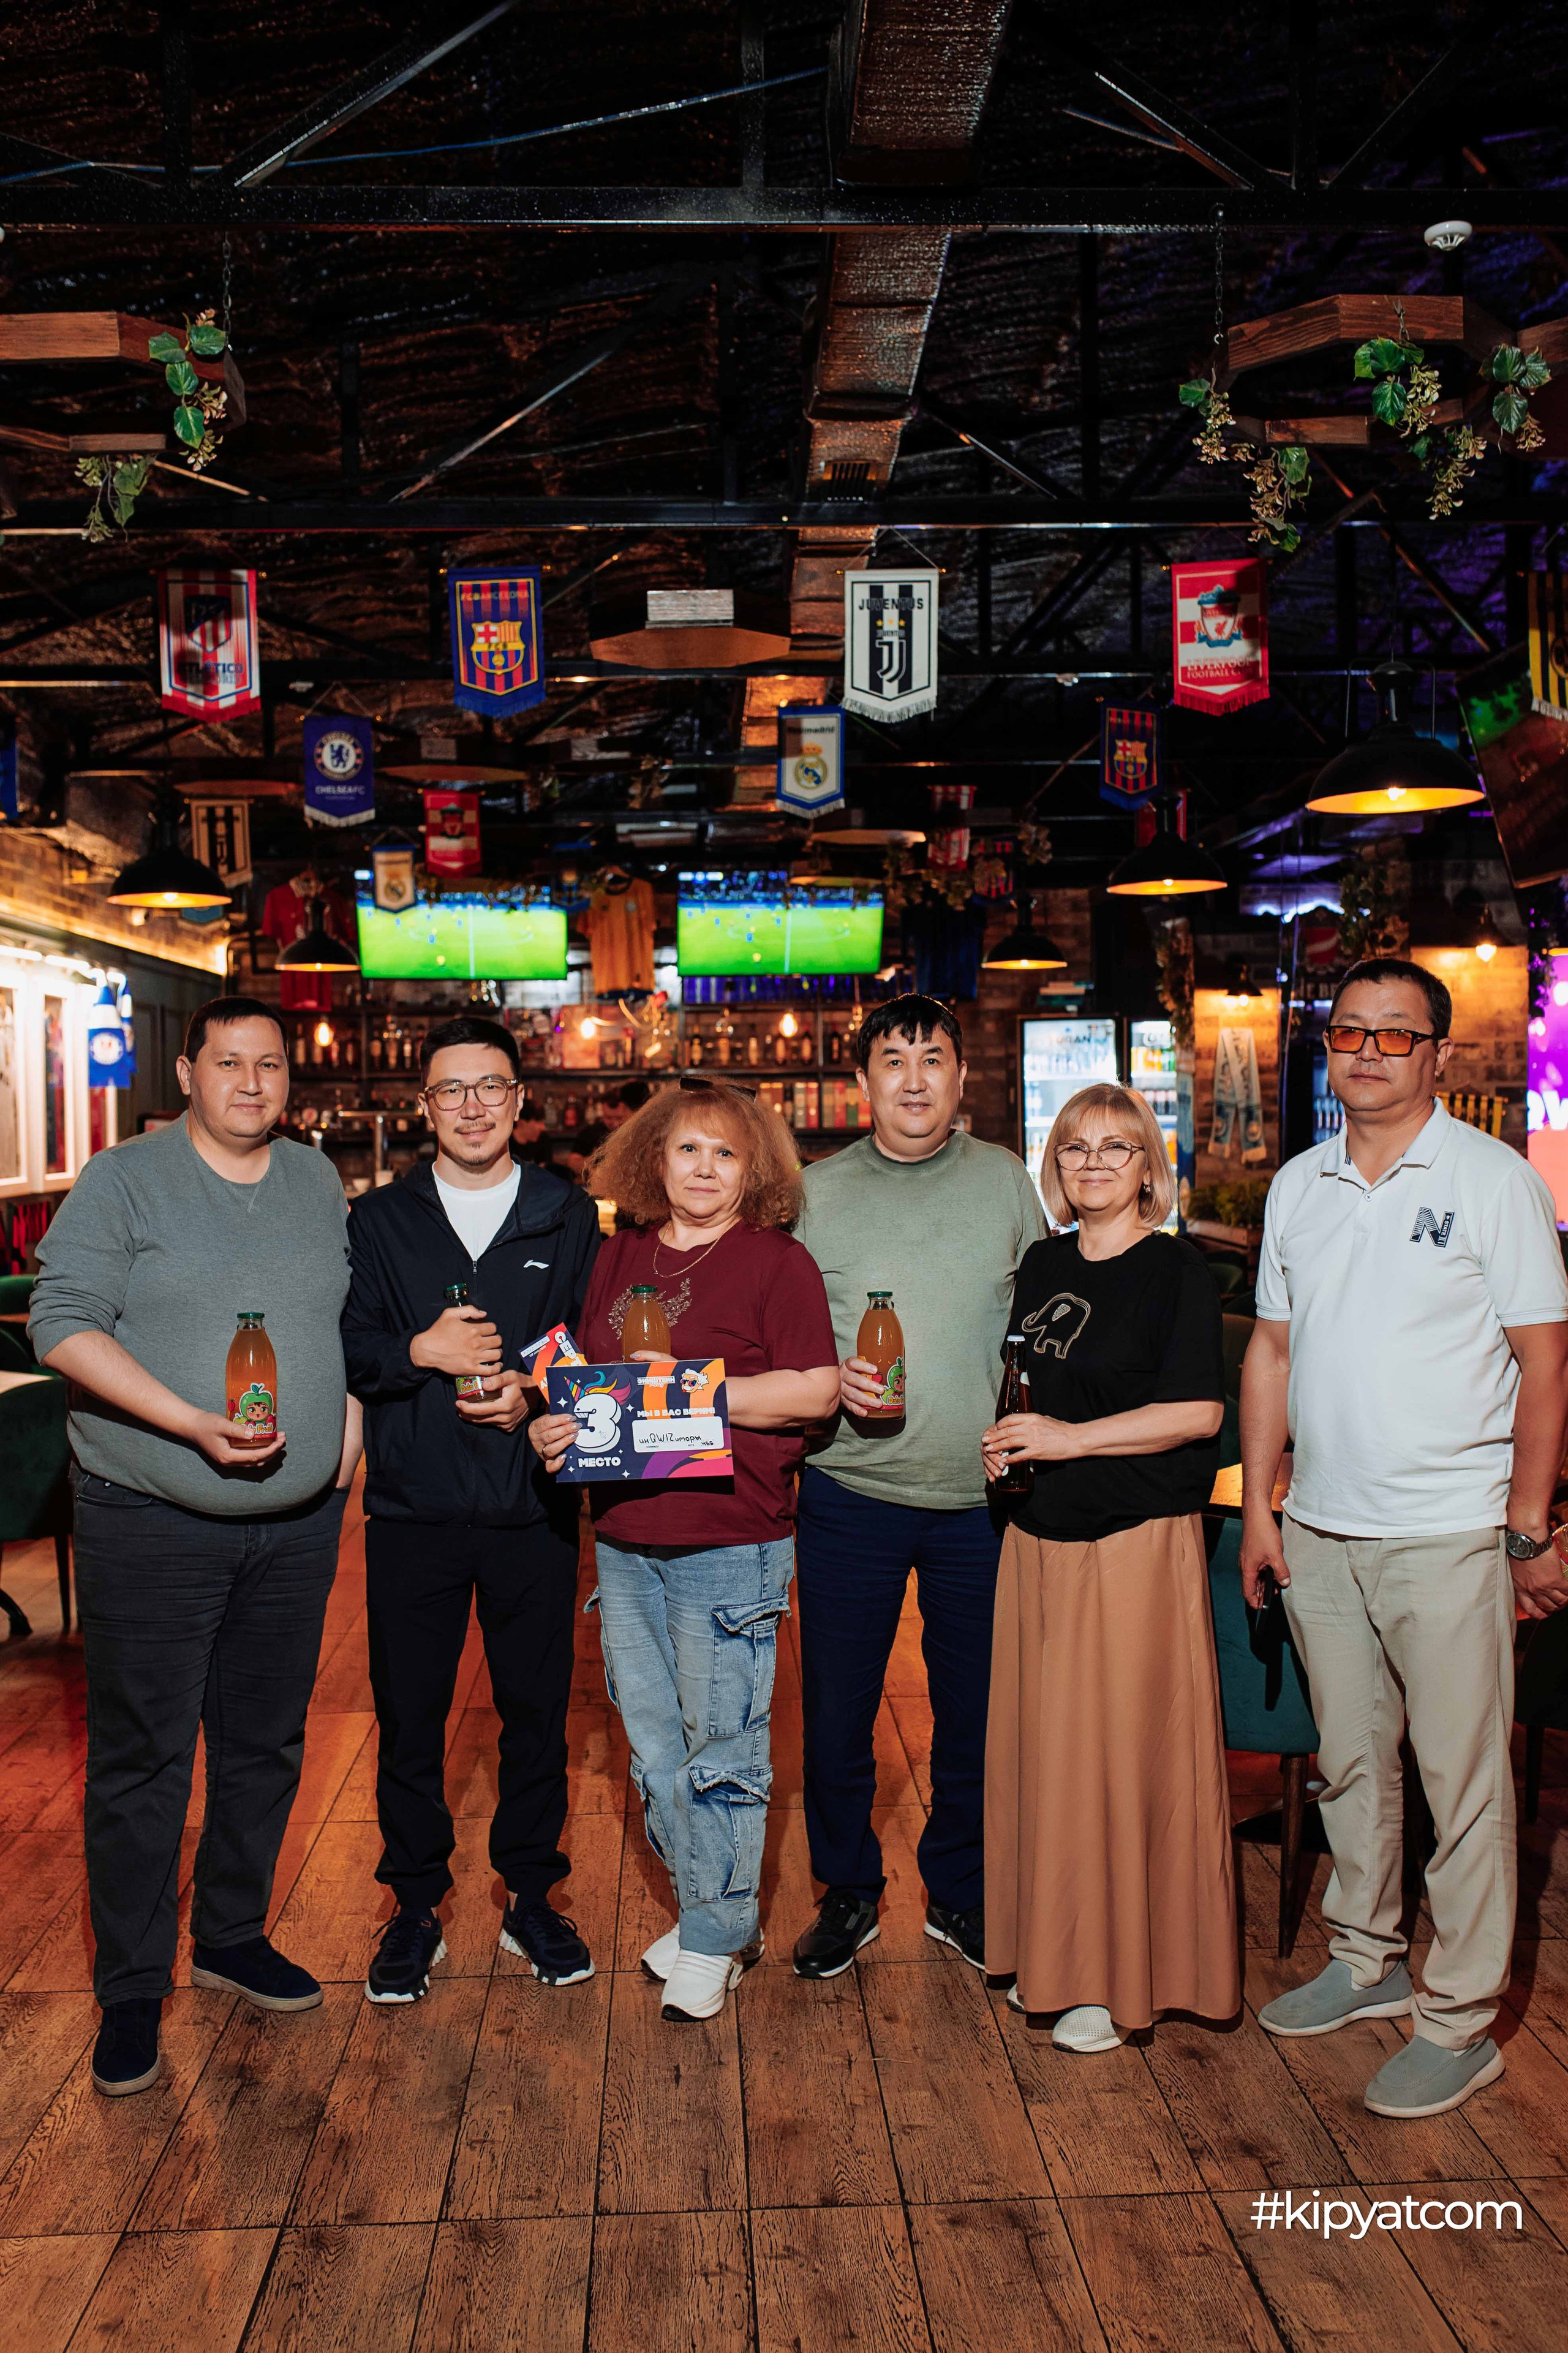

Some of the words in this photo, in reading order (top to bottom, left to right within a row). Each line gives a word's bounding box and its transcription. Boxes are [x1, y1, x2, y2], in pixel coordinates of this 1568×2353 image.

[859, 597, 924, 611] JUVENTUS
[1441, 1220, 1450, 1236] STATE
[683, 1407, 715, 1415] ВЕРИМ!
[257, 1422, 274, 1434] Fruit
[574, 1392, 622, 1454] 3
[578, 1456, 621, 1468] МЕСТО
